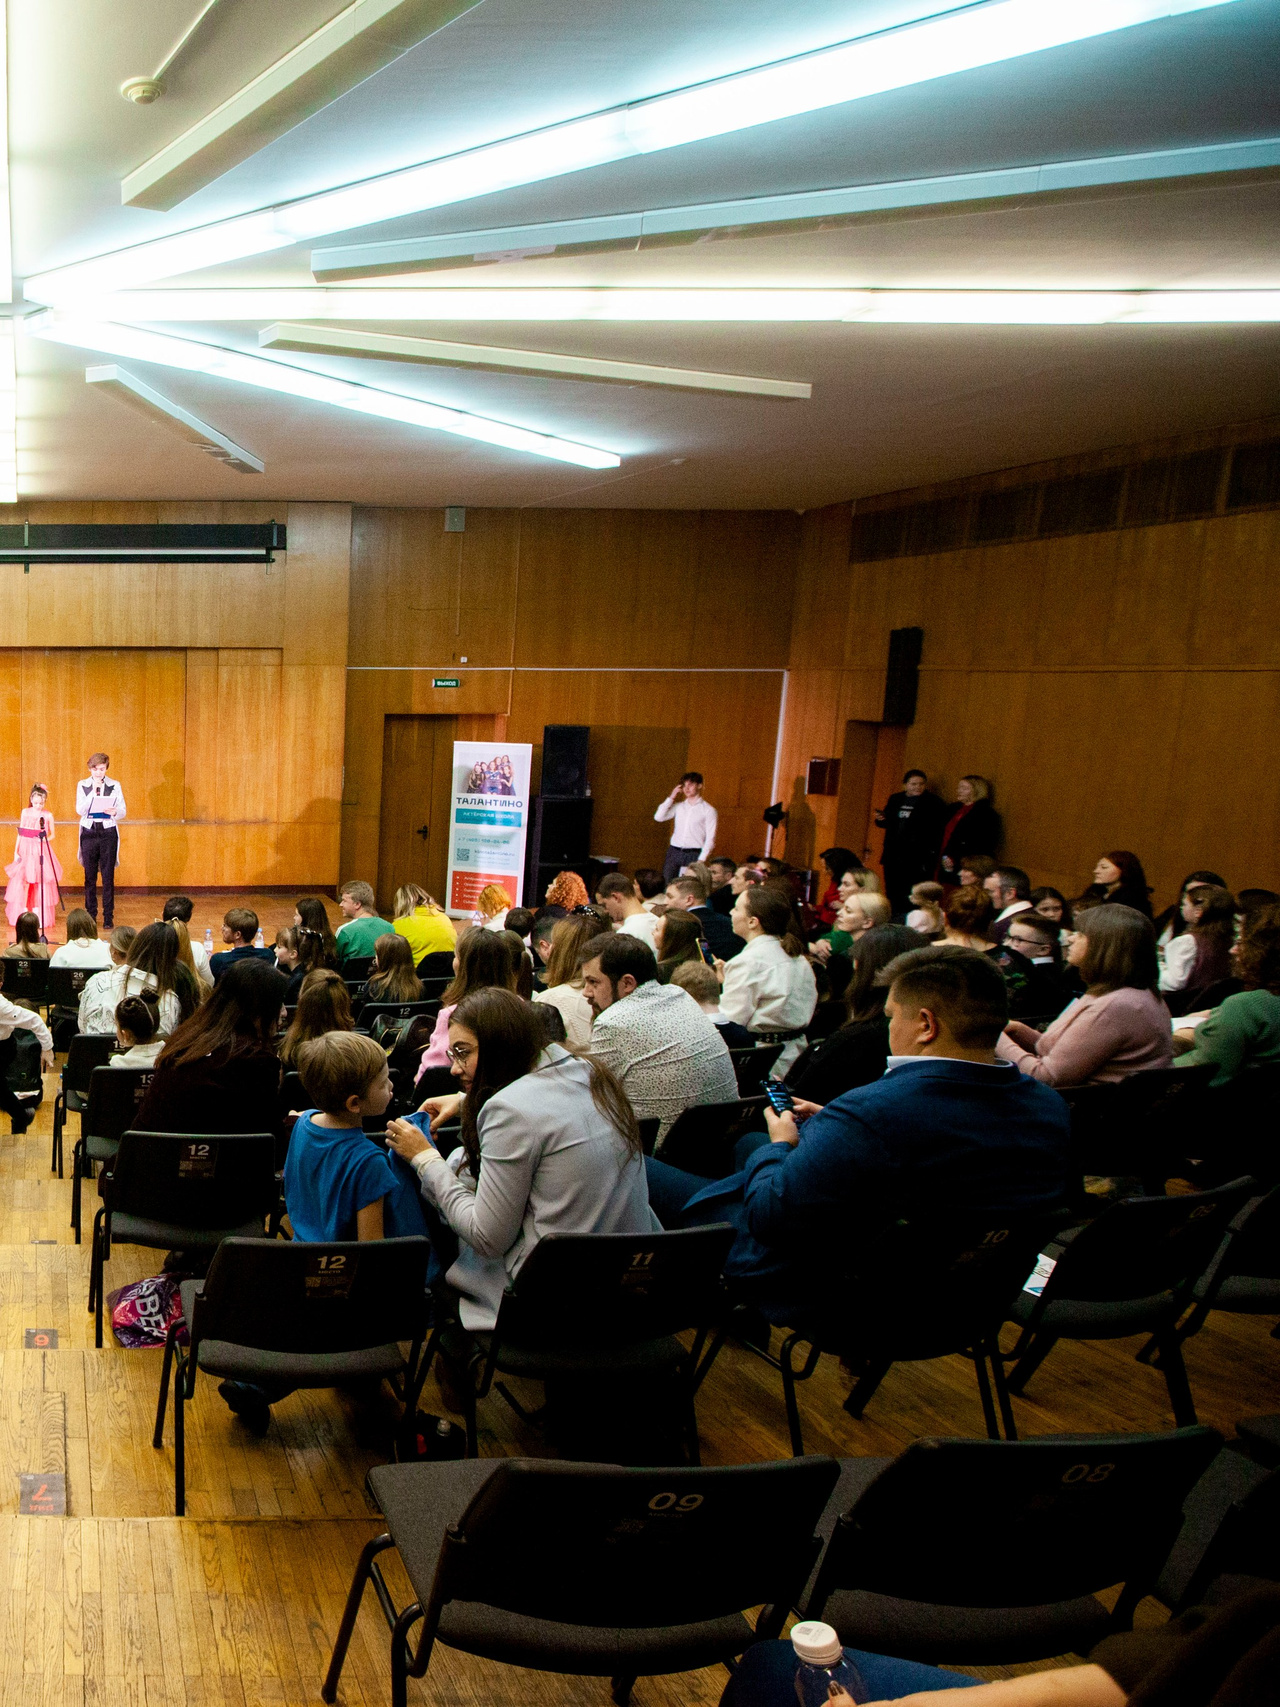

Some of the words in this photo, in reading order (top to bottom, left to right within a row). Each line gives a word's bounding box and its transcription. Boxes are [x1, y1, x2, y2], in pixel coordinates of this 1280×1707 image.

[456, 797, 523, 808] ТАЛАНТИНО
[399, 1007, 411, 1015] 12
[740, 1106, 756, 1118] 11
[188, 1144, 210, 1156] 12
[982, 1229, 1010, 1244] 10
[317, 1255, 347, 1269] 12
[632, 1251, 655, 1266] 11
[1061, 1462, 1116, 1484] 08
[32, 1483, 53, 1501] 7
[648, 1492, 705, 1512] 09
